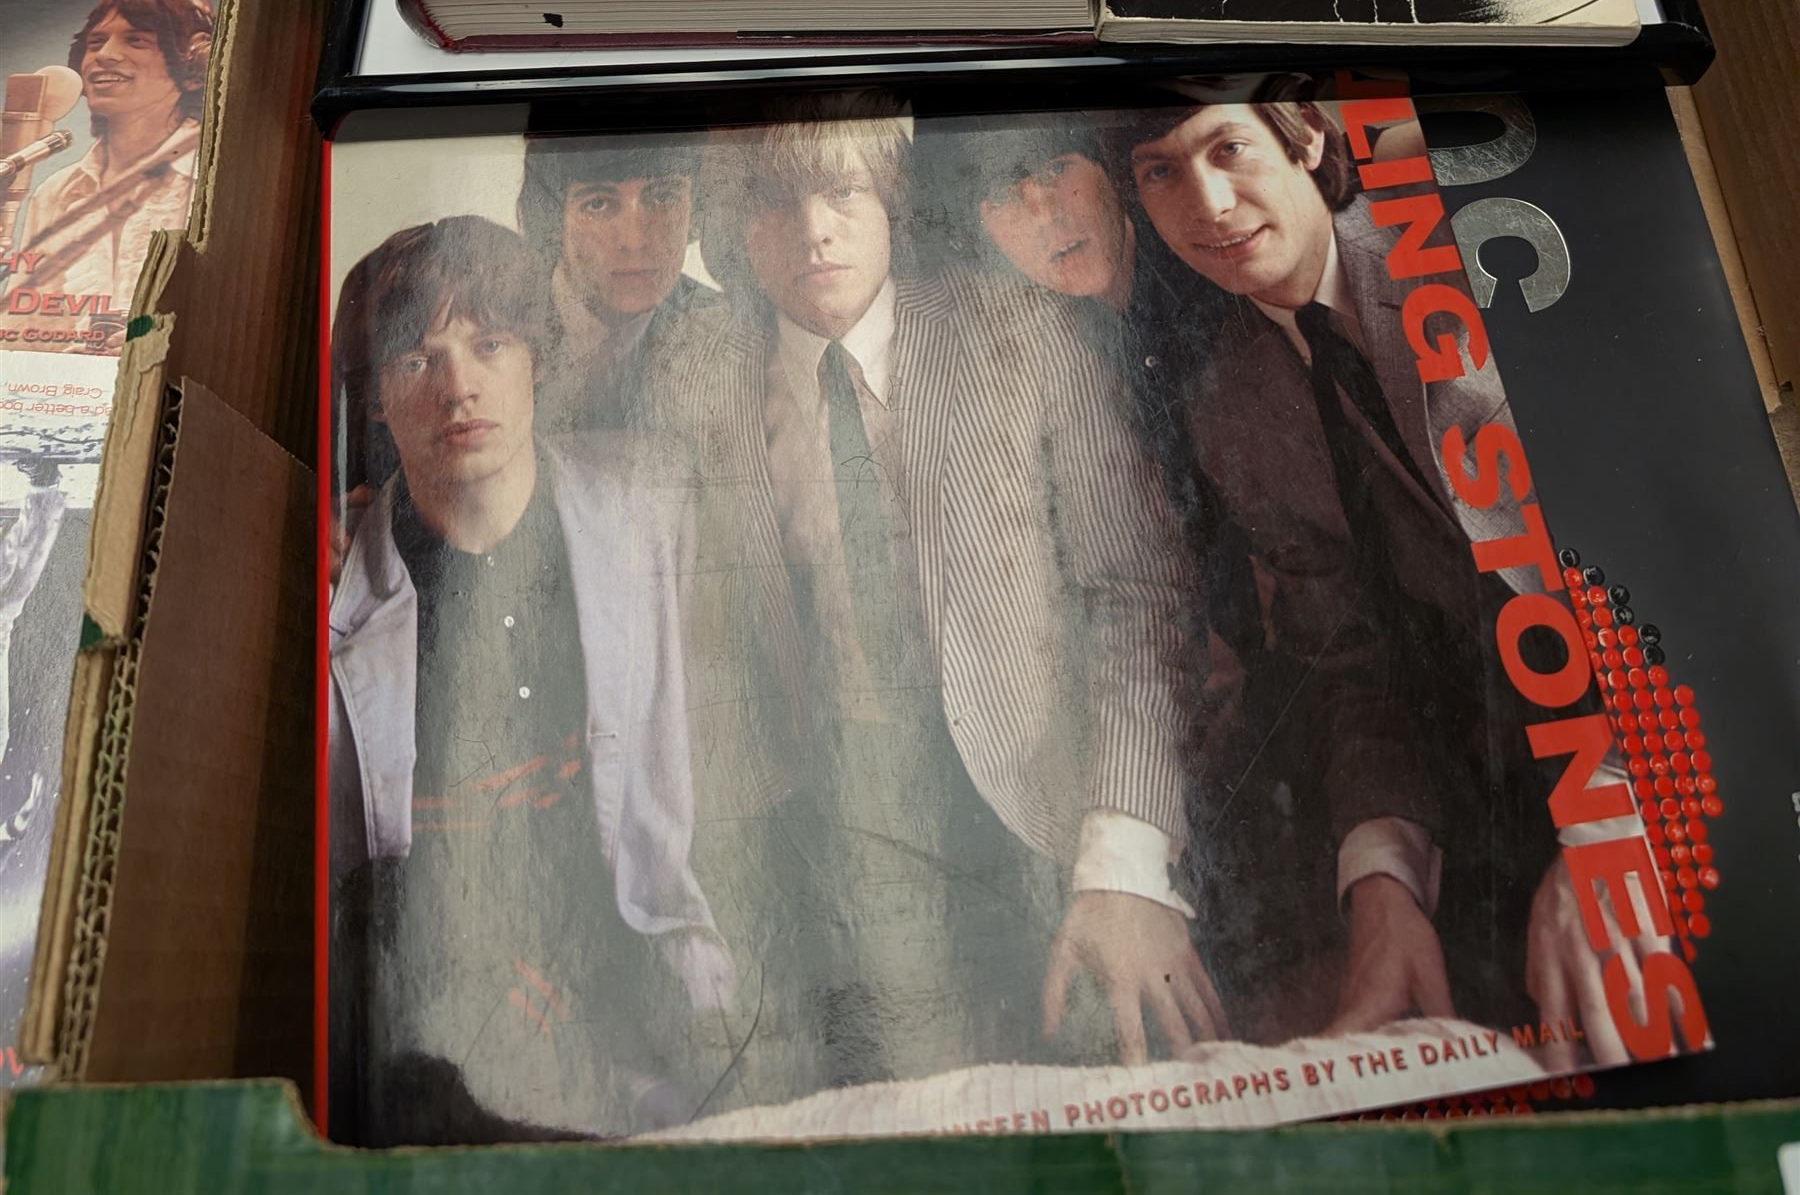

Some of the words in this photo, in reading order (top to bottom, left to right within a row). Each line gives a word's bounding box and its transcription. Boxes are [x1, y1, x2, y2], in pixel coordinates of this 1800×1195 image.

[8, 287, 121, 316] DEVIL
[22, 327, 106, 343] GODARD
[4, 382, 58, 397] Brown,
[63, 383, 103, 400] Craig
[31, 402, 75, 416] better
[80, 404, 90, 414] a
[1440, 422, 1708, 1064] STONES
[928, 1107, 1052, 1136] SEEN
[1063, 1067, 1291, 1127] PHOTOGRAPHS
[1300, 1059, 1335, 1087] BY
[1347, 1047, 1407, 1078] THE
[1416, 1030, 1500, 1066] DAILY
[1511, 1017, 1584, 1049] MAIL
